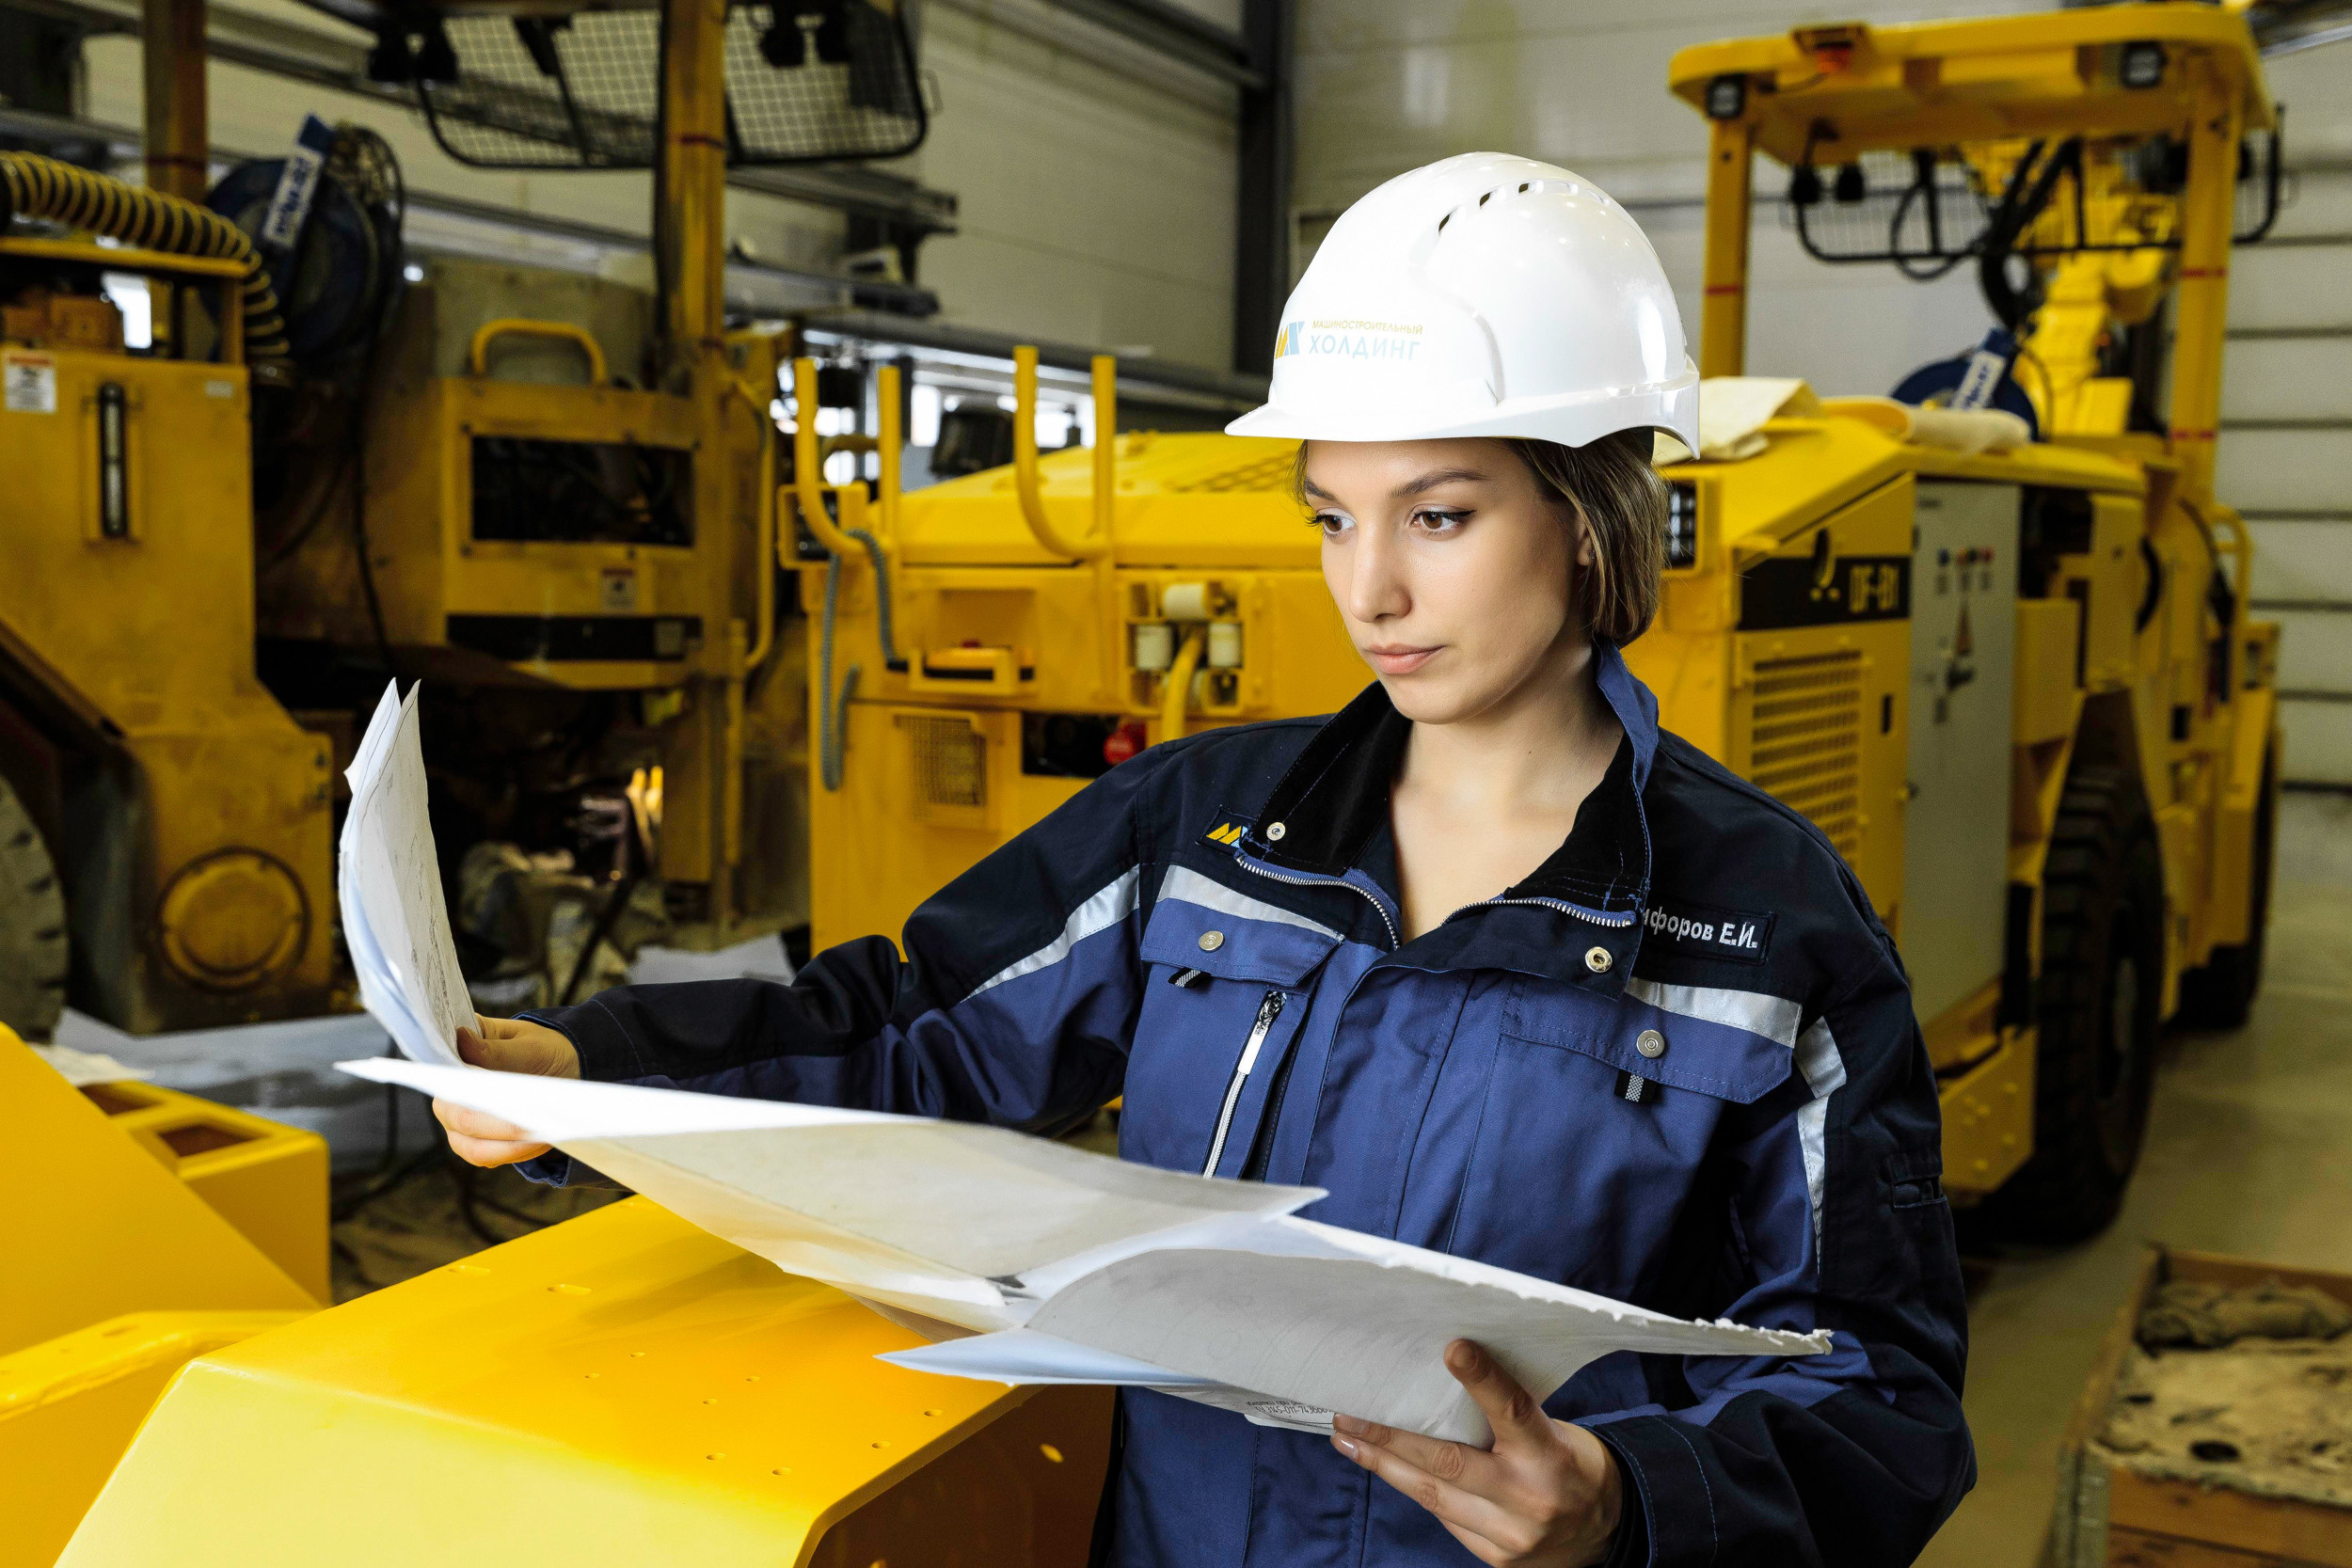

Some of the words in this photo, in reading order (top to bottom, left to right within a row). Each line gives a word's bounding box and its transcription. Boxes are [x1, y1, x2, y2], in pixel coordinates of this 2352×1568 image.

[1311, 320, 1423, 335] МАШИНОСТРОИТЕЛЬНЫЙ
[1309, 334, 1422, 361] ХОЛДИНГ
[1718, 921, 1758, 948] Е.И.
